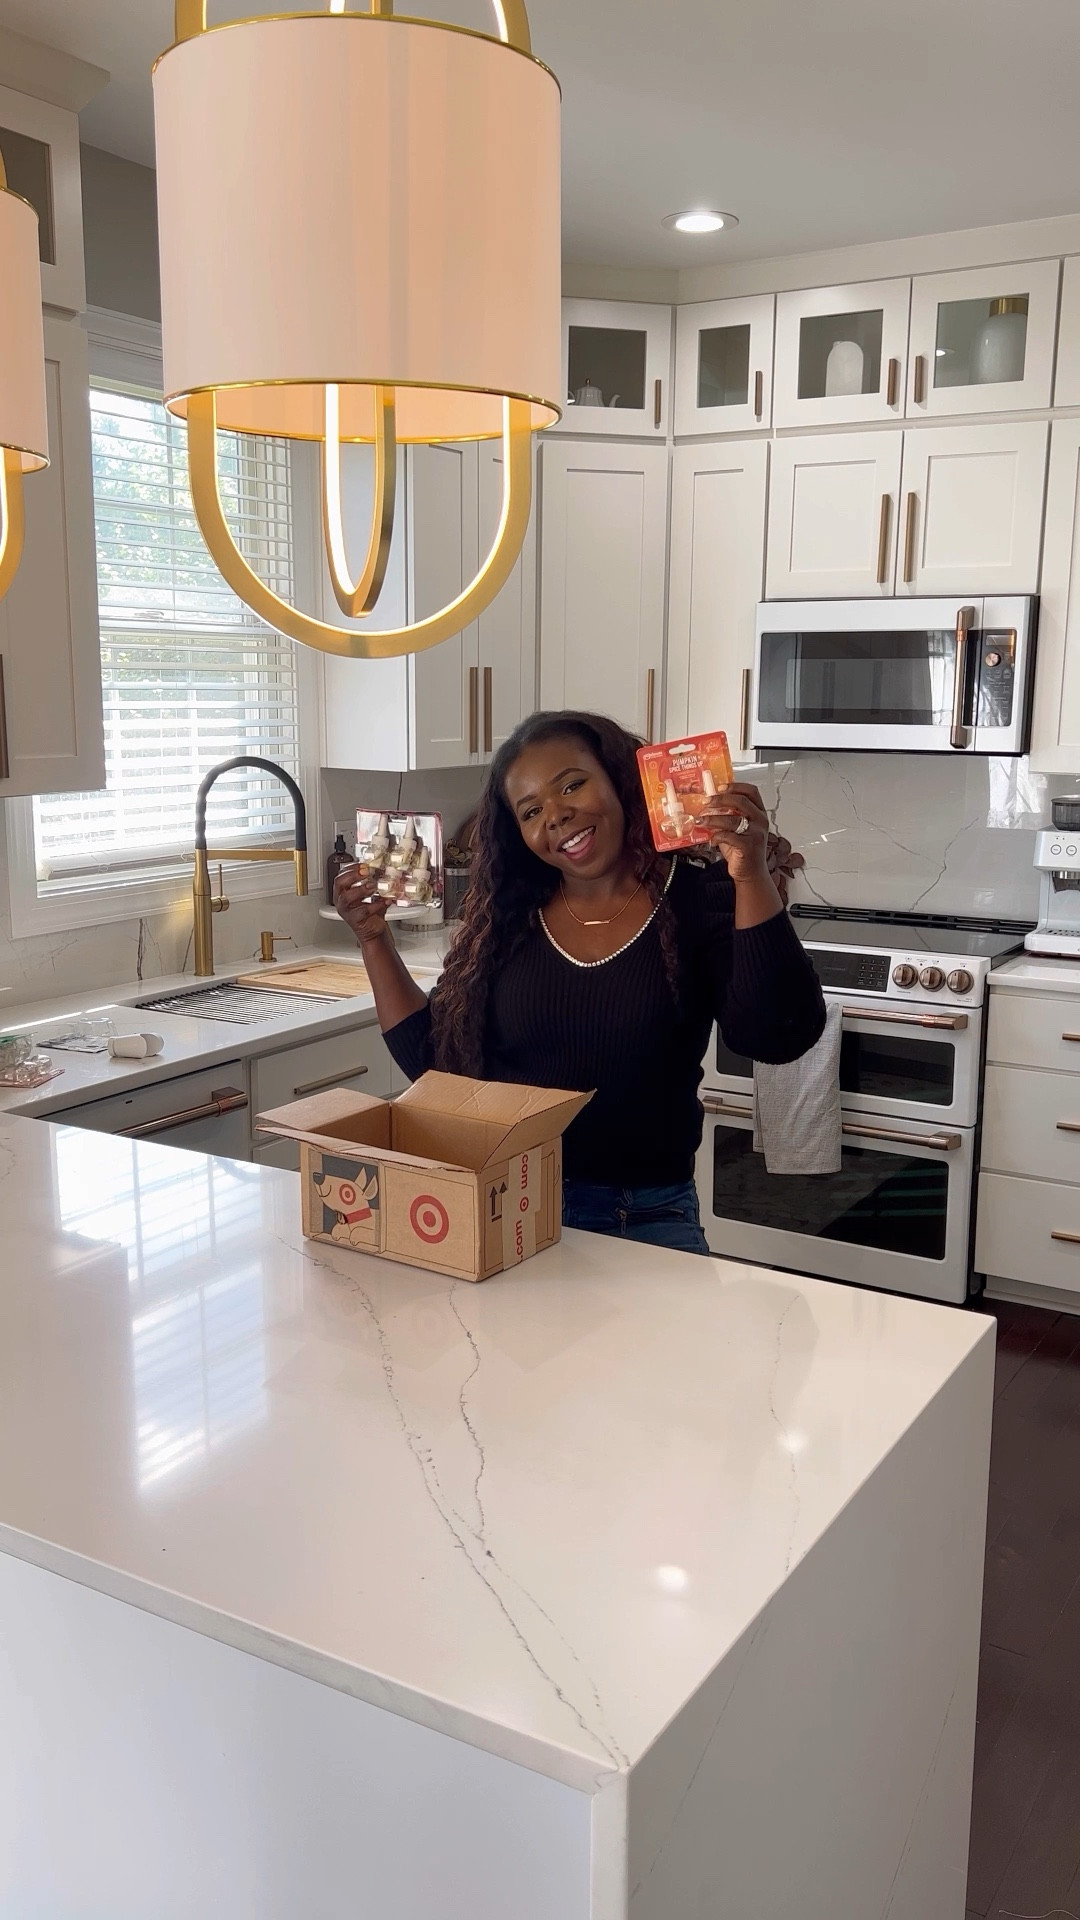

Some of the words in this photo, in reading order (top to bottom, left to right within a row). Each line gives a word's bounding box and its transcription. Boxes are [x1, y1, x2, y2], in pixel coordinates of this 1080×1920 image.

[672, 755, 698, 767] PUMPKIN
[681, 761, 697, 771] THINGS
[697, 760, 704, 768] UP
